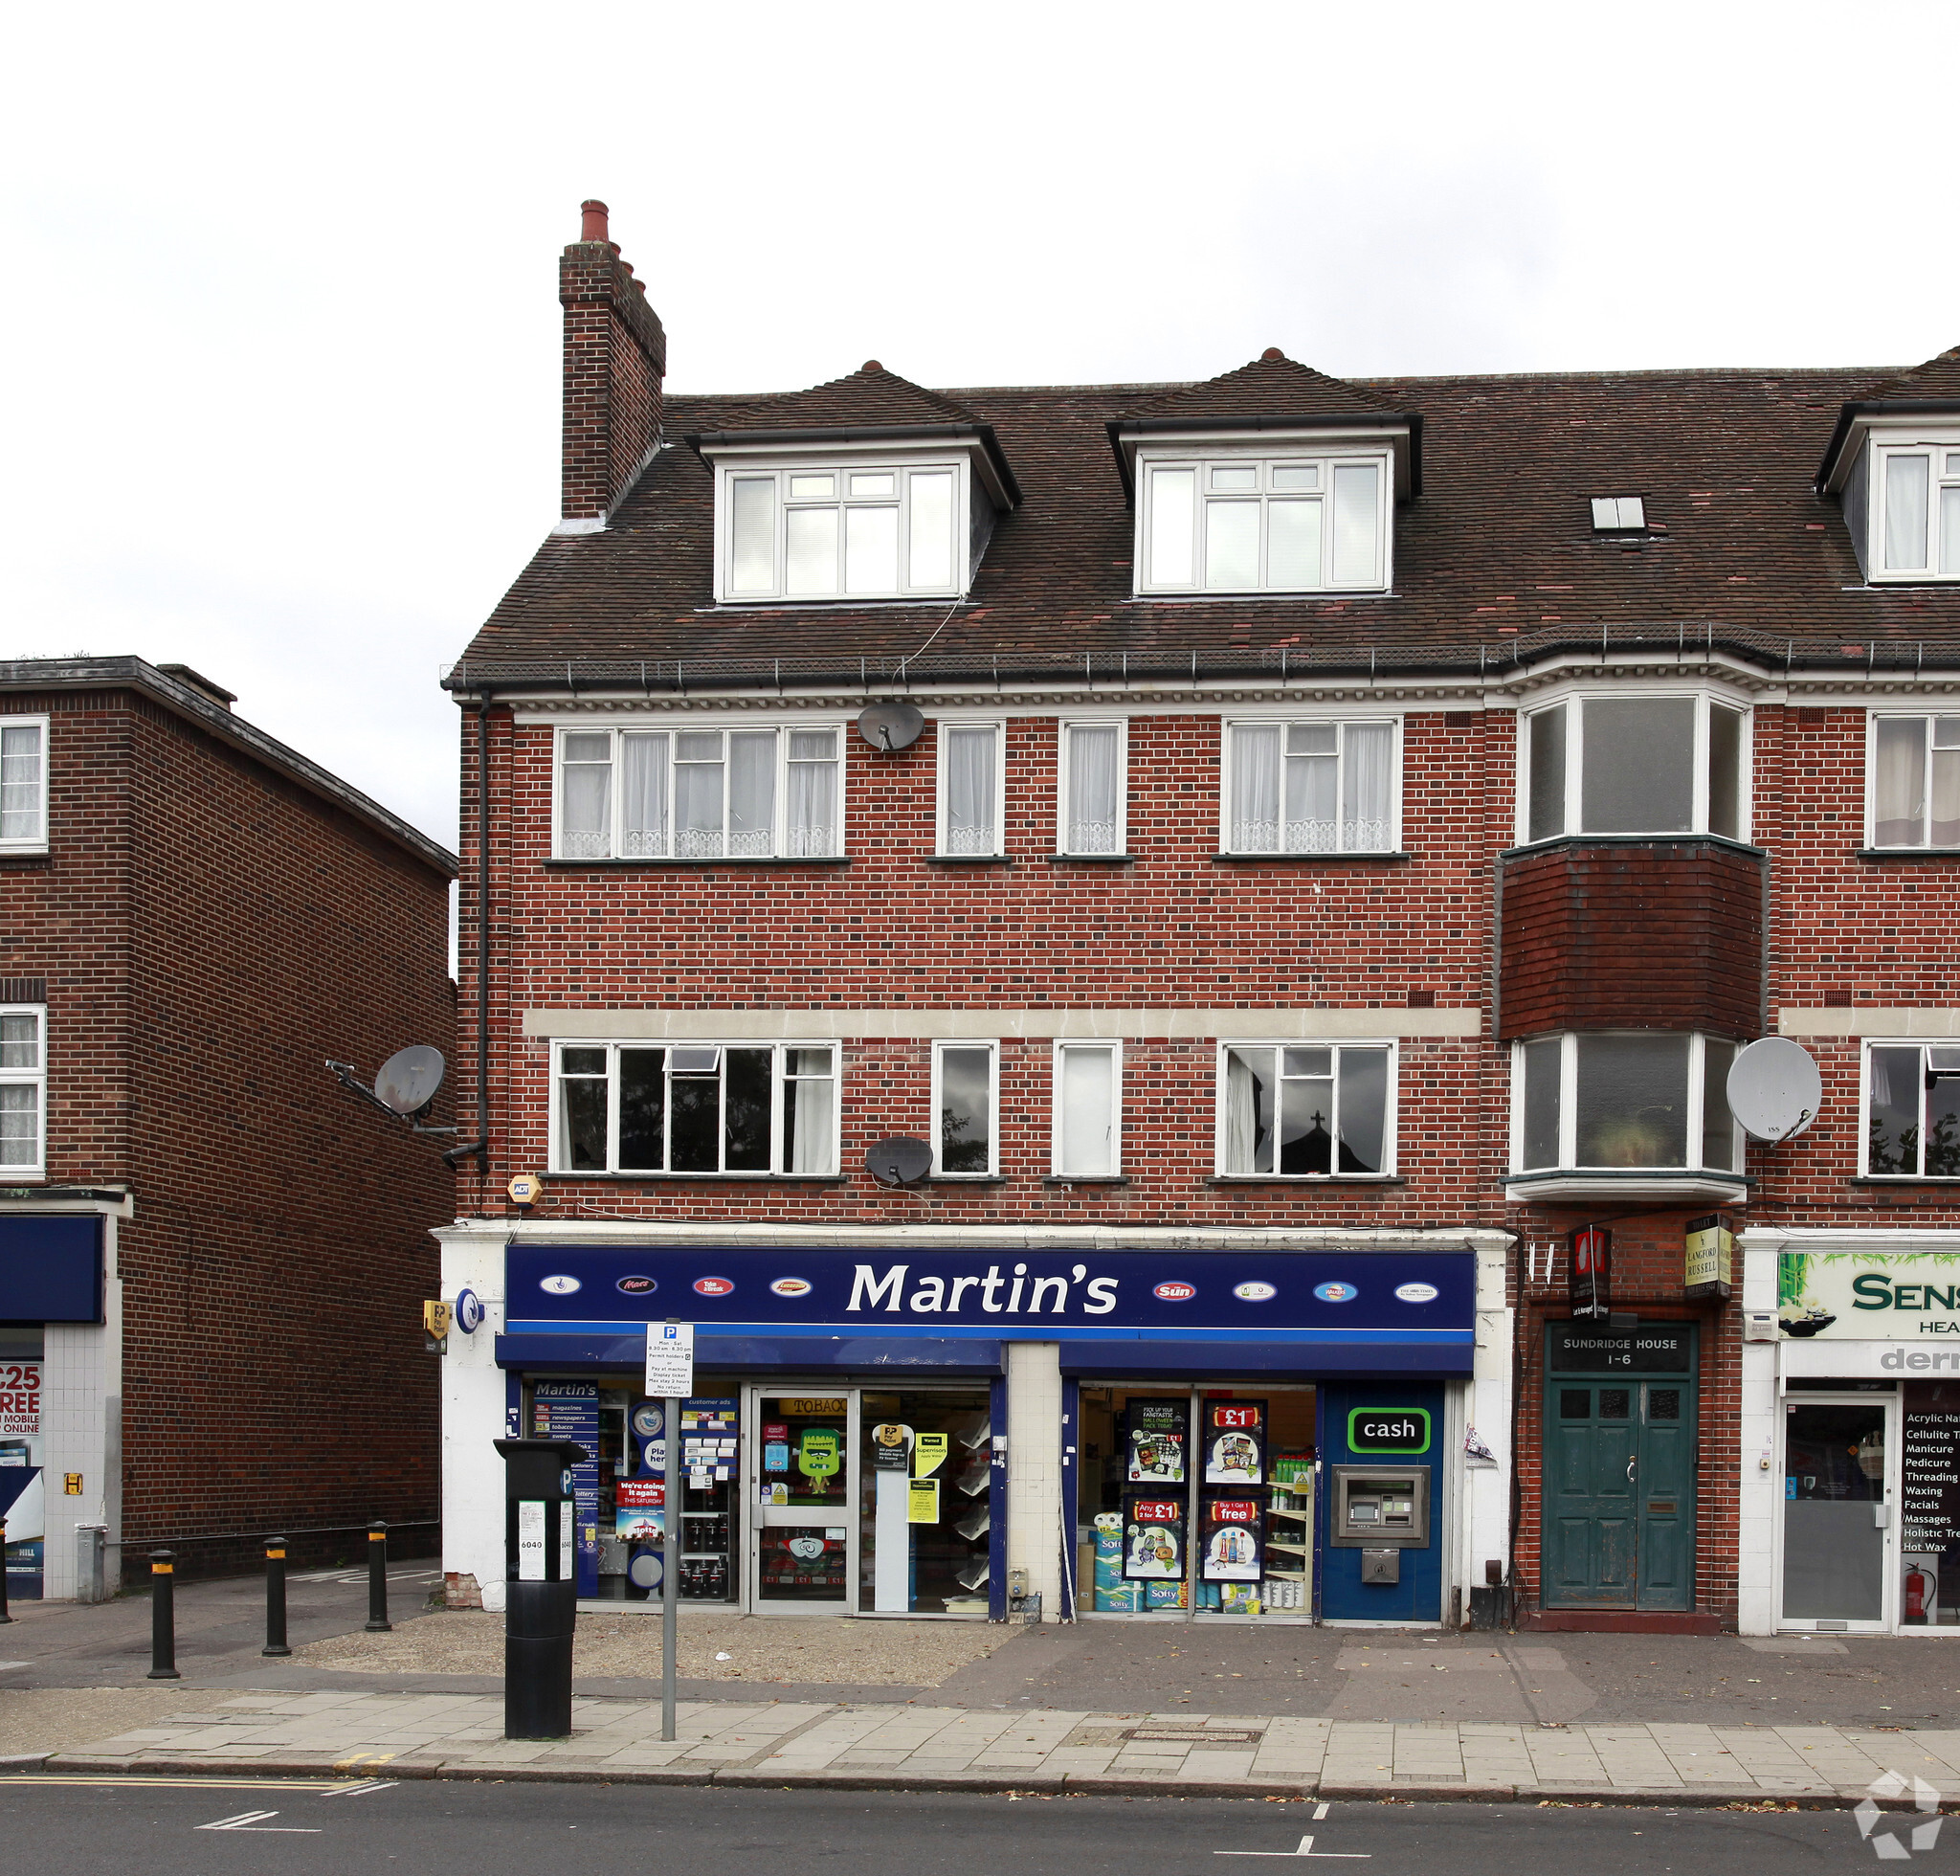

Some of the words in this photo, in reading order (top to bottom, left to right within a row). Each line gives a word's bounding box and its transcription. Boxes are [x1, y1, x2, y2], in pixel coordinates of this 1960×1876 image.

[514, 1185, 529, 1194] ADT
[1687, 1247, 1716, 1262] LANGFORD
[1687, 1262, 1716, 1277] RUSSELL
[624, 1281, 649, 1289] Mars
[845, 1262, 1119, 1314] Martin's
[1158, 1286, 1191, 1296] Sun
[667, 1328, 675, 1338] P
[1563, 1339, 1631, 1349] SUNDRIDGE
[1636, 1339, 1678, 1350] HOUSE
[536, 1384, 596, 1396] Martin's
[793, 1399, 847, 1413] TOBACC
[4, 1415, 39, 1423] MOBILE
[1225, 1409, 1246, 1425] £1
[1906, 1414, 1943, 1424] Acrylic
[4, 1424, 39, 1433] ONLINE
[1364, 1419, 1415, 1438] cash
[1905, 1430, 1950, 1440] Cellulite
[1905, 1444, 1954, 1453] Manicure
[1905, 1458, 1951, 1467] Pedicure
[563, 1469, 572, 1494] P
[1905, 1472, 1958, 1484] Threading
[643, 1483, 666, 1491] doing
[1904, 1486, 1943, 1497] Waxing
[1139, 1504, 1154, 1512] Any
[1904, 1501, 1940, 1509] Facials
[1154, 1504, 1173, 1519] £1
[1220, 1508, 1247, 1519] free
[1904, 1514, 1951, 1526] Massages
[1904, 1529, 1943, 1537] Holistic
[1102, 1540, 1123, 1549] Soft
[1904, 1543, 1923, 1552] Hot
[1925, 1543, 1947, 1552] Wax
[1151, 1590, 1177, 1599] Softy
